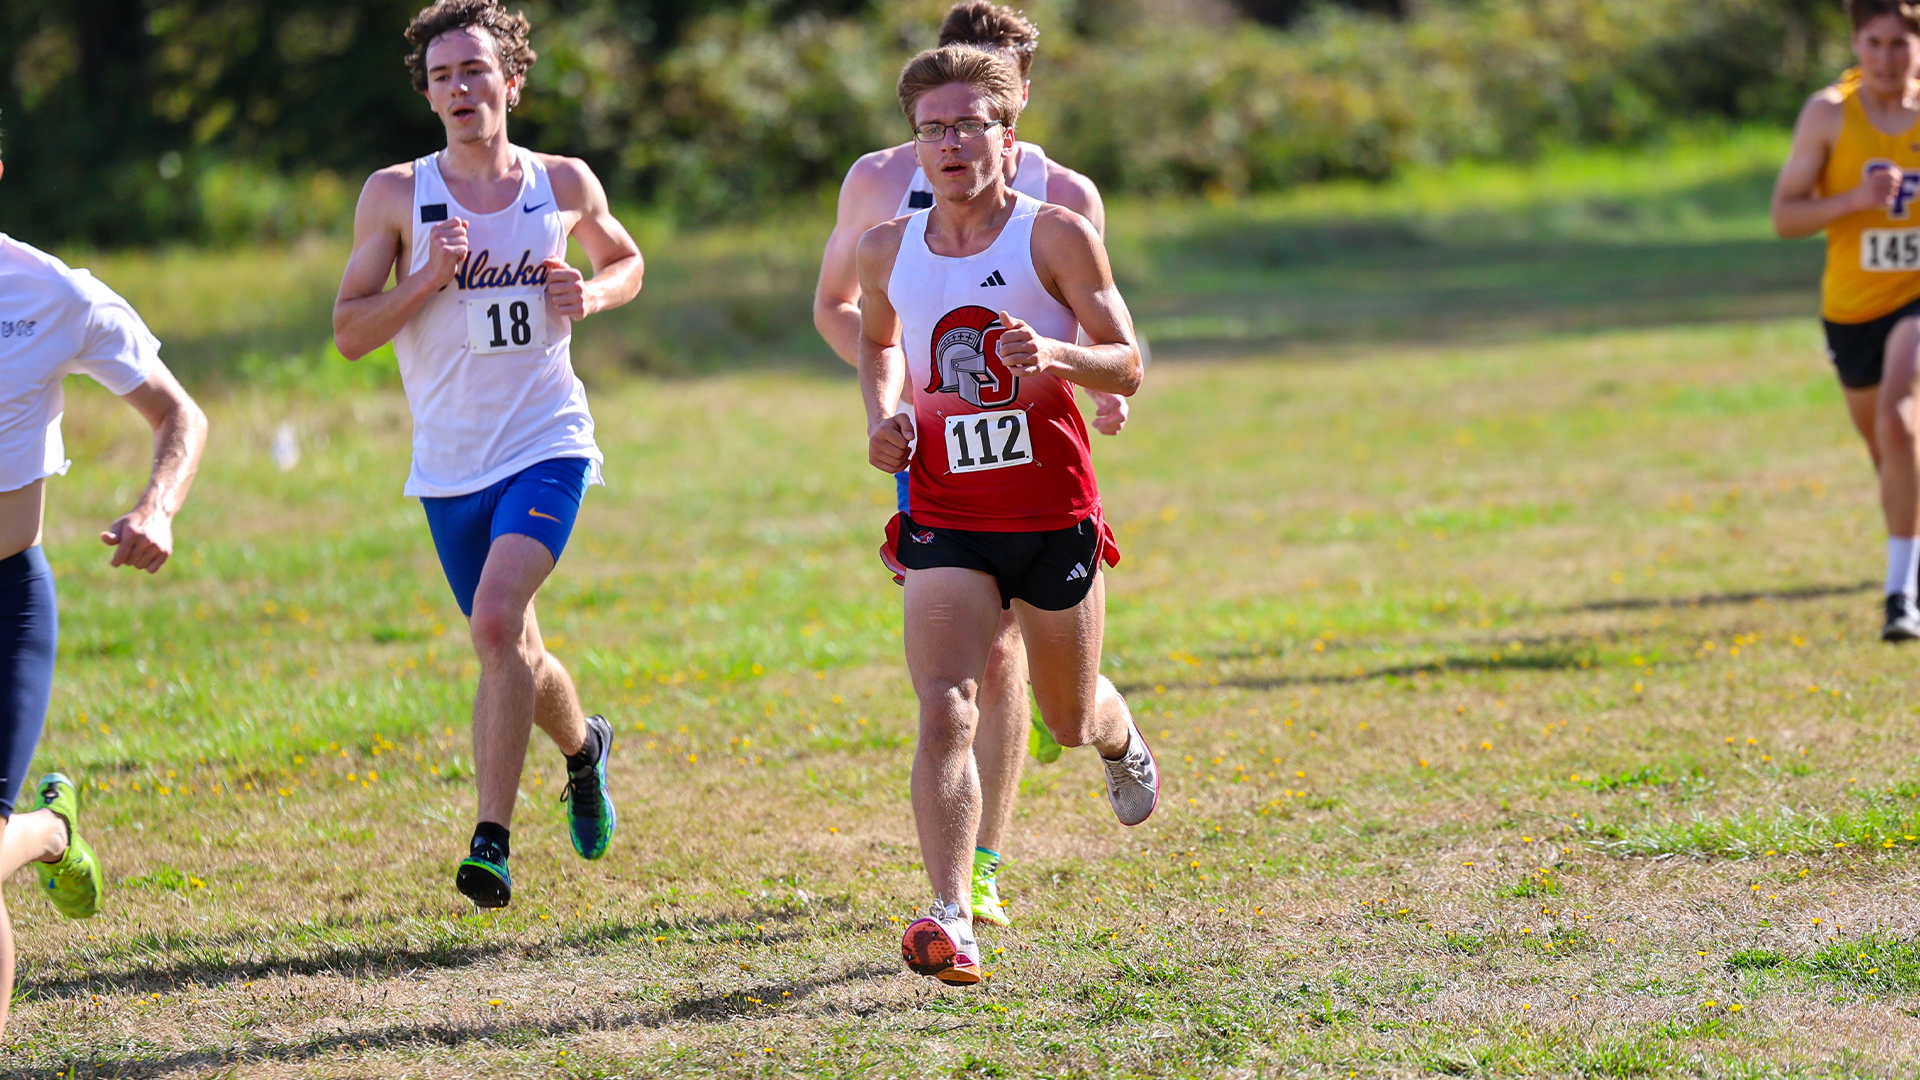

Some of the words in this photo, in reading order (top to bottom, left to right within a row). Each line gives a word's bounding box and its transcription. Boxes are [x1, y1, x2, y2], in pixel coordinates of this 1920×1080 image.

[1868, 231, 1919, 267] 145
[486, 300, 532, 348] 18
[952, 415, 1025, 467] 112
